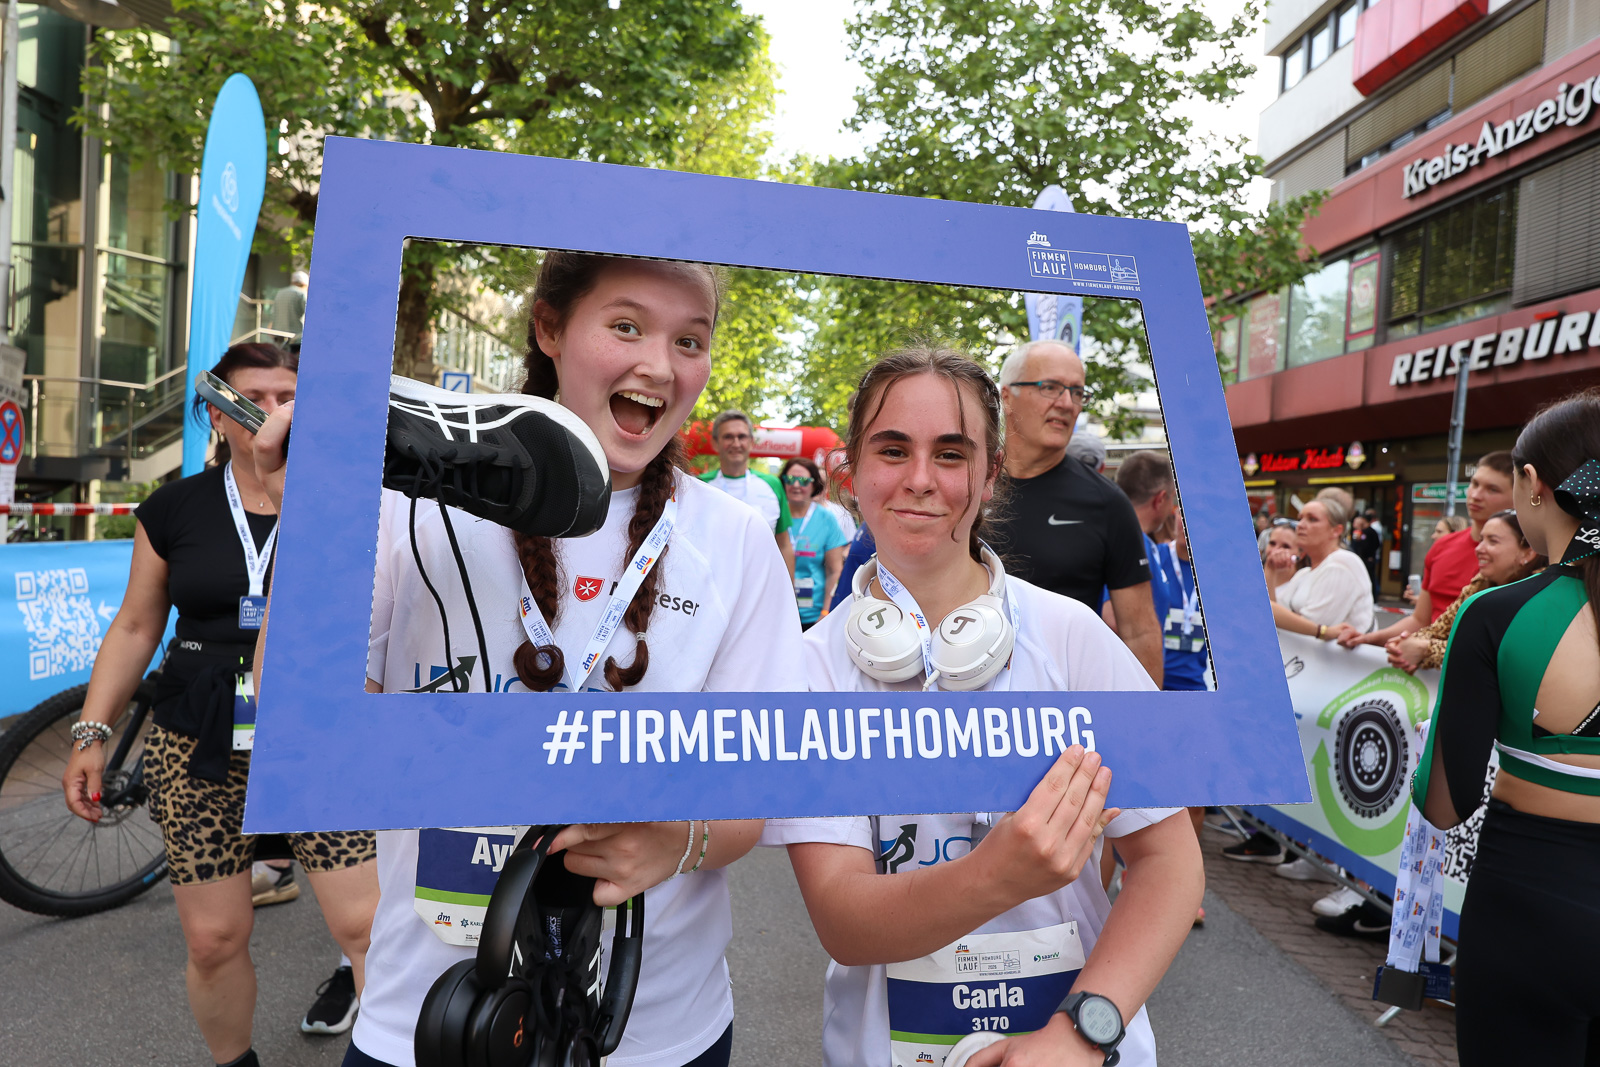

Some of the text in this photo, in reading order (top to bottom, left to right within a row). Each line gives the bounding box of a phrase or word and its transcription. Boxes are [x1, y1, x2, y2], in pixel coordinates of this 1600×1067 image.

[1029, 231, 1047, 241] dm
[1032, 251, 1066, 262] FIRMEN
[1034, 261, 1067, 276] LAUF
[1073, 262, 1107, 272] HOMBURG
[635, 555, 649, 571] dm
[522, 596, 532, 612] dm
[531, 624, 543, 639] LAUF
[582, 652, 595, 671] dm
[542, 706, 1096, 765] #FIRMENLAUFHOMBURG
[471, 836, 514, 872] Ay
[437, 911, 451, 922] dm
[957, 943, 968, 951] dm
[958, 962, 978, 972] LAUF
[952, 982, 1025, 1010] Carla
[971, 1016, 1010, 1032] 3170
[918, 1051, 932, 1060] dm
